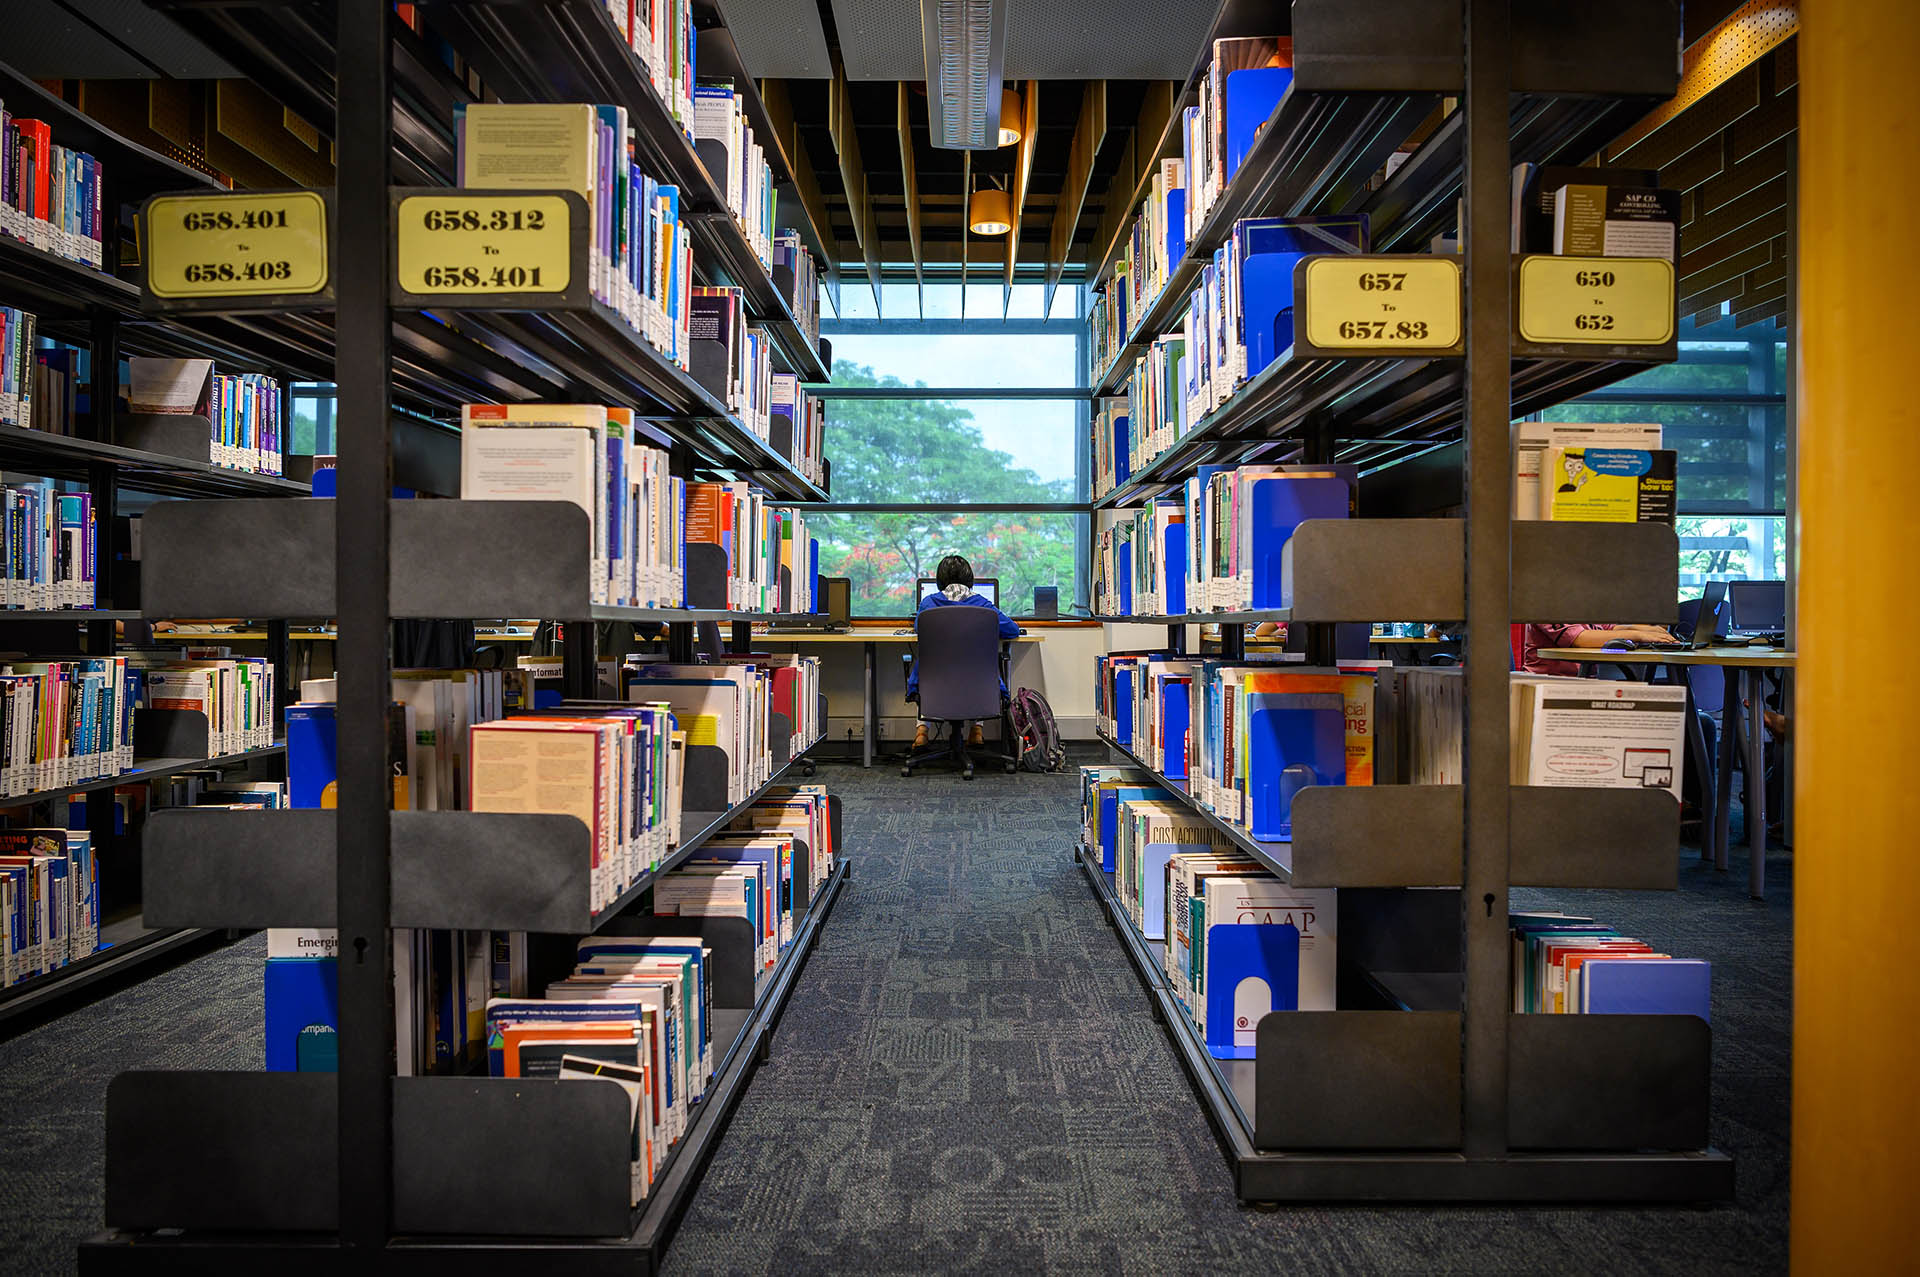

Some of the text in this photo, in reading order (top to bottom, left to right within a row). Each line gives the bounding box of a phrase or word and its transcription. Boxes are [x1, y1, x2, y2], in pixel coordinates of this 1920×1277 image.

[1626, 194, 1657, 202] SAP CO
[182, 209, 289, 232] 658.401
[423, 209, 545, 232] 658.312
[237, 244, 250, 252] To
[482, 245, 500, 256] To
[183, 261, 292, 284] 658.403
[423, 266, 544, 289] 658.401
[1575, 271, 1616, 288] 650
[1359, 273, 1408, 292] 657
[1381, 304, 1396, 312] To
[1339, 321, 1429, 341] 657.83
[1575, 314, 1615, 331] 652
[1640, 483, 1660, 491] how
[1153, 826, 1175, 844] COST
